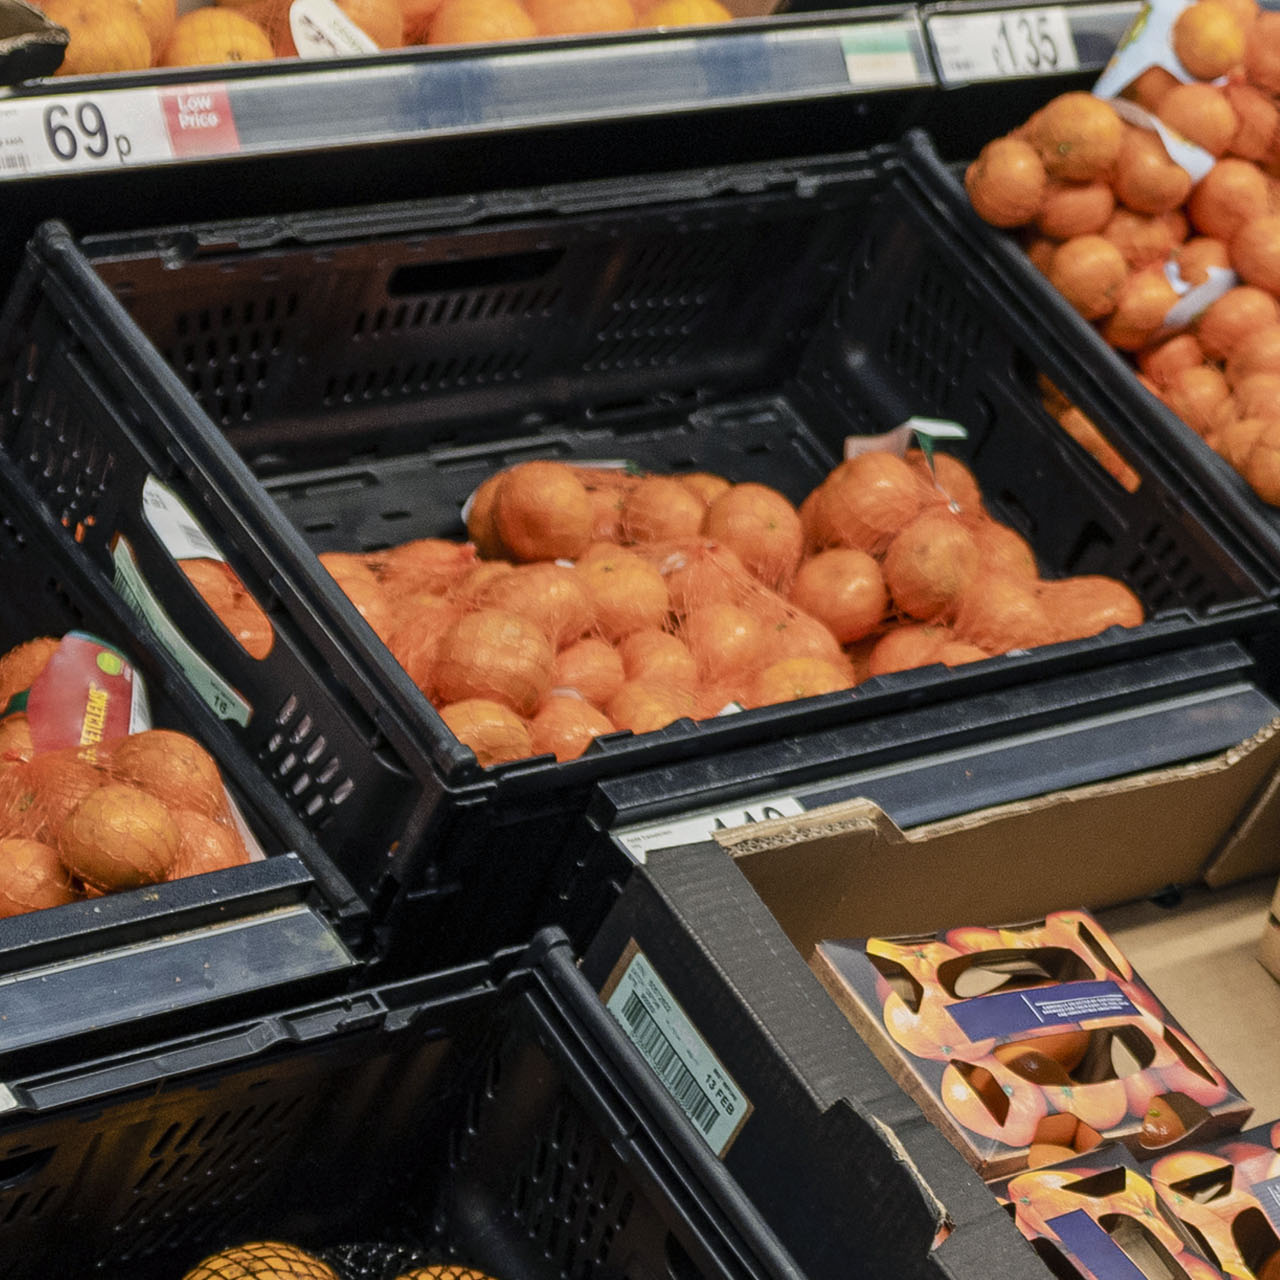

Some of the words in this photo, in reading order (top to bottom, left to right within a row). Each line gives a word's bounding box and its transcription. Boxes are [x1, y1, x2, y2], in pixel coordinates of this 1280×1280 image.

[177, 95, 212, 112] Low
[178, 112, 218, 129] Price
[78, 681, 108, 766] ETCLEMS
[705, 1073, 716, 1090] 13
[715, 1088, 735, 1116] FEB
